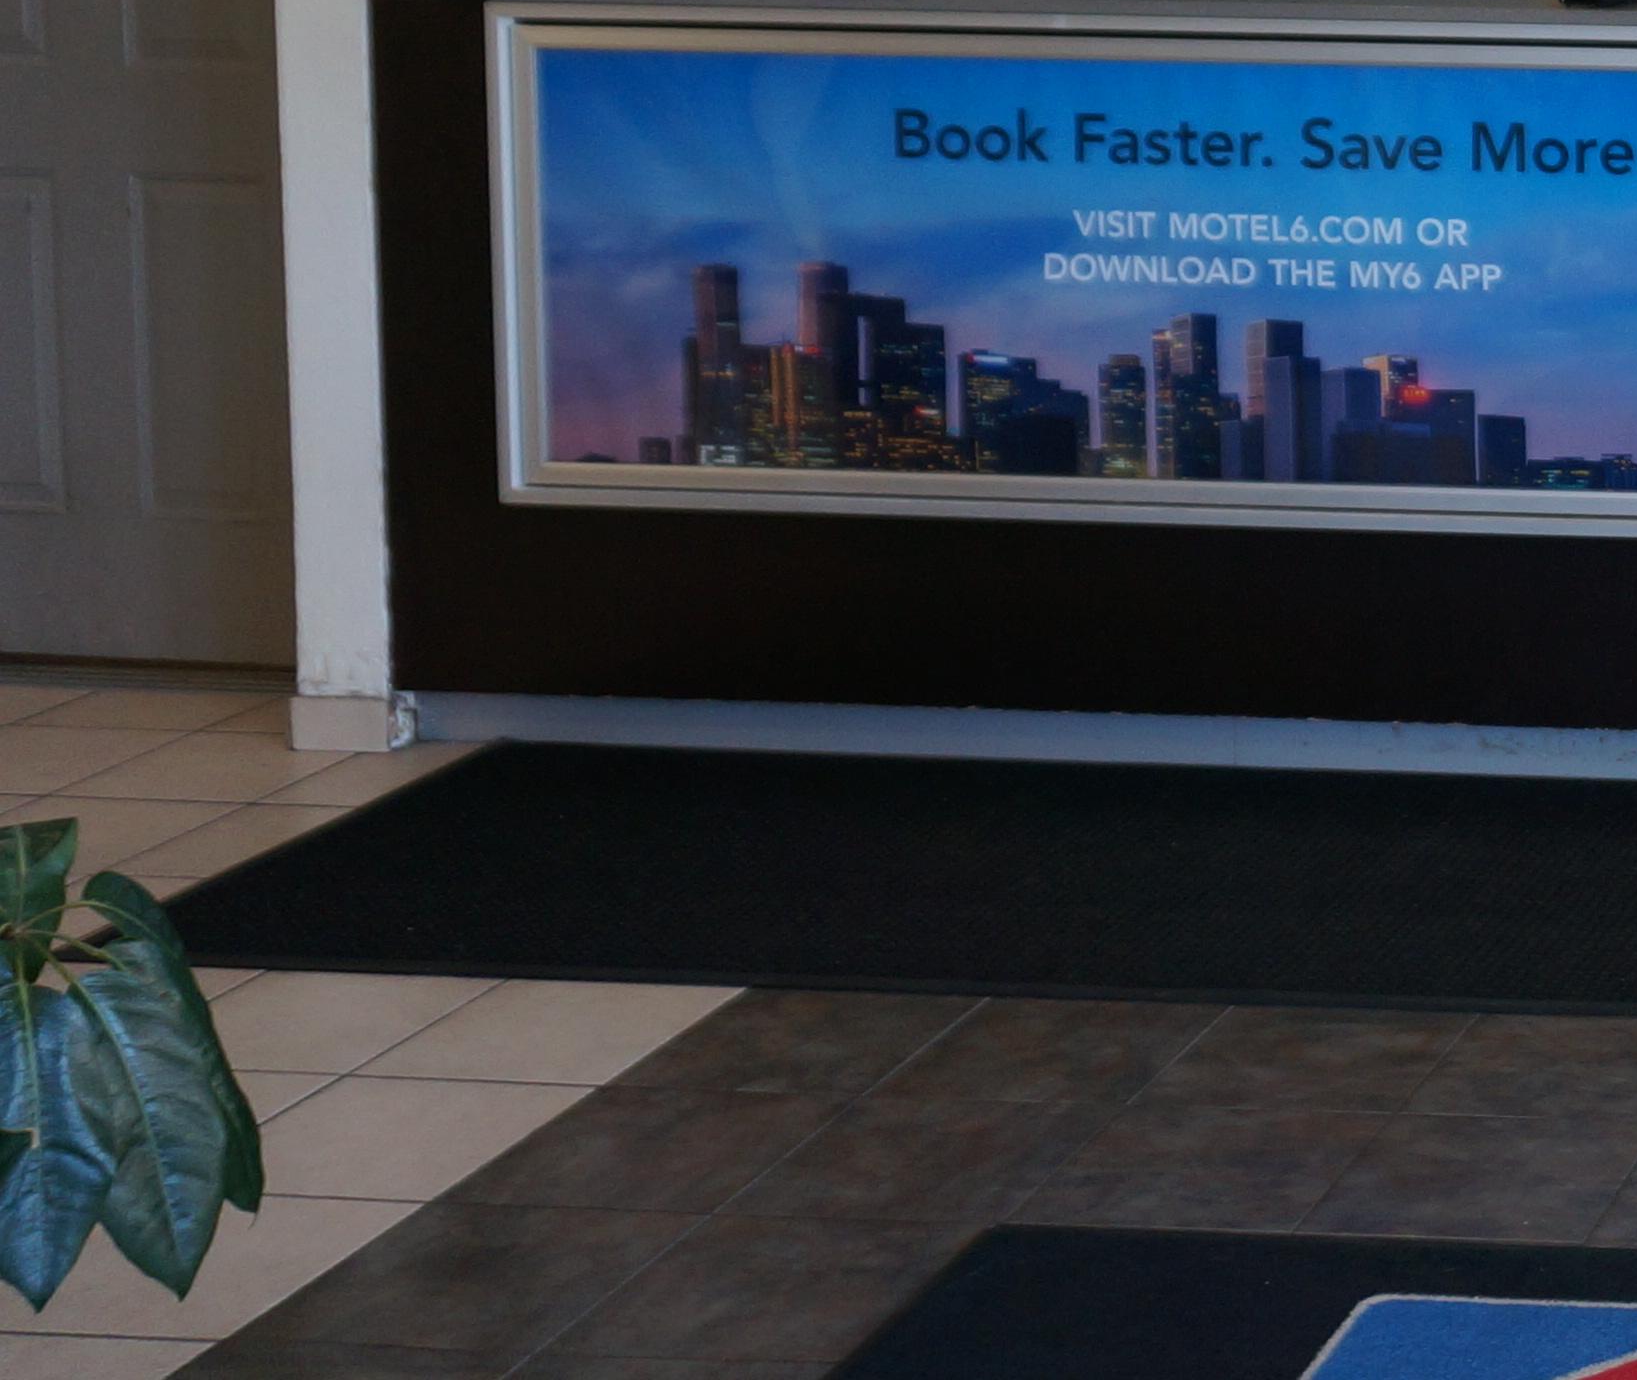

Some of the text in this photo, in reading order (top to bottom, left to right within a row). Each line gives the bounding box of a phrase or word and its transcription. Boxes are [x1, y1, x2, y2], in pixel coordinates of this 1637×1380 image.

[892, 107, 1049, 162] Book
[1074, 112, 1273, 169] Faster.
[1300, 117, 1442, 171] Save
[1073, 209, 1468, 247] VISIT MOTEL6.COM OR
[1043, 253, 1502, 291] DOWNLOAD THE MY6 APP
